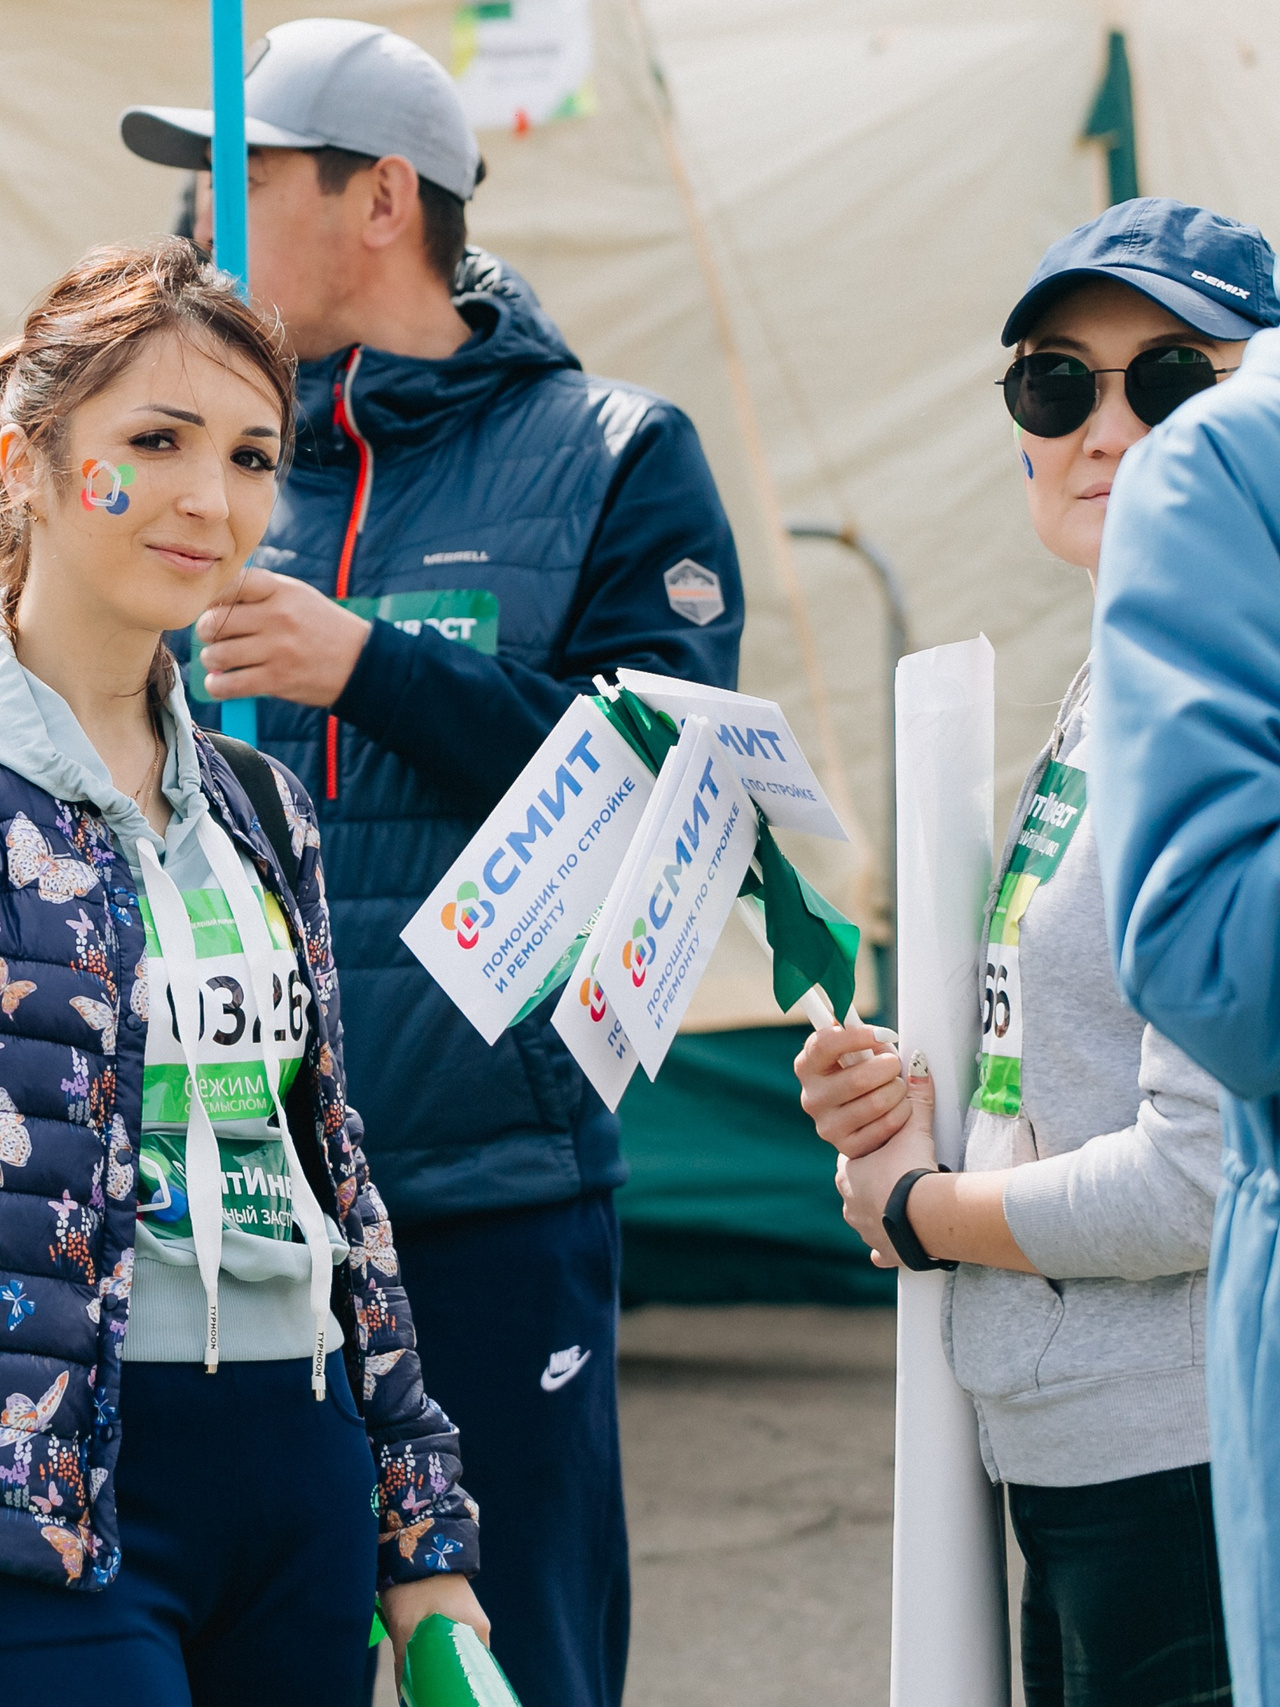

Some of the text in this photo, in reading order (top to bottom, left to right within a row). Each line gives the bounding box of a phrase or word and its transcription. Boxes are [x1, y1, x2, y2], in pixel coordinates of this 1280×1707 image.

[1190, 269, 1251, 300] DEMIX
[680, 718, 787, 762] МИТ
[483, 729, 601, 895] СМИТ
[747, 778, 766, 792] ПО
[766, 781, 817, 801] СТРОЙКЕ
[482, 877, 560, 978] ПОМОЩНИК
[556, 853, 578, 880] ПО
[578, 776, 636, 852] СТРОЙКЕ
[649, 756, 719, 930] СМИТ
[494, 977, 508, 994] И
[506, 898, 565, 978] РЕМОНТУ
[646, 801, 740, 1015] ПОМОЩНИК ПО СТРОЙКЕ
[654, 929, 701, 1030] И РЕМОНТУ
[260, 1208, 292, 1228] ЗАСТ
[315, 1331, 324, 1378] TYPHOON
